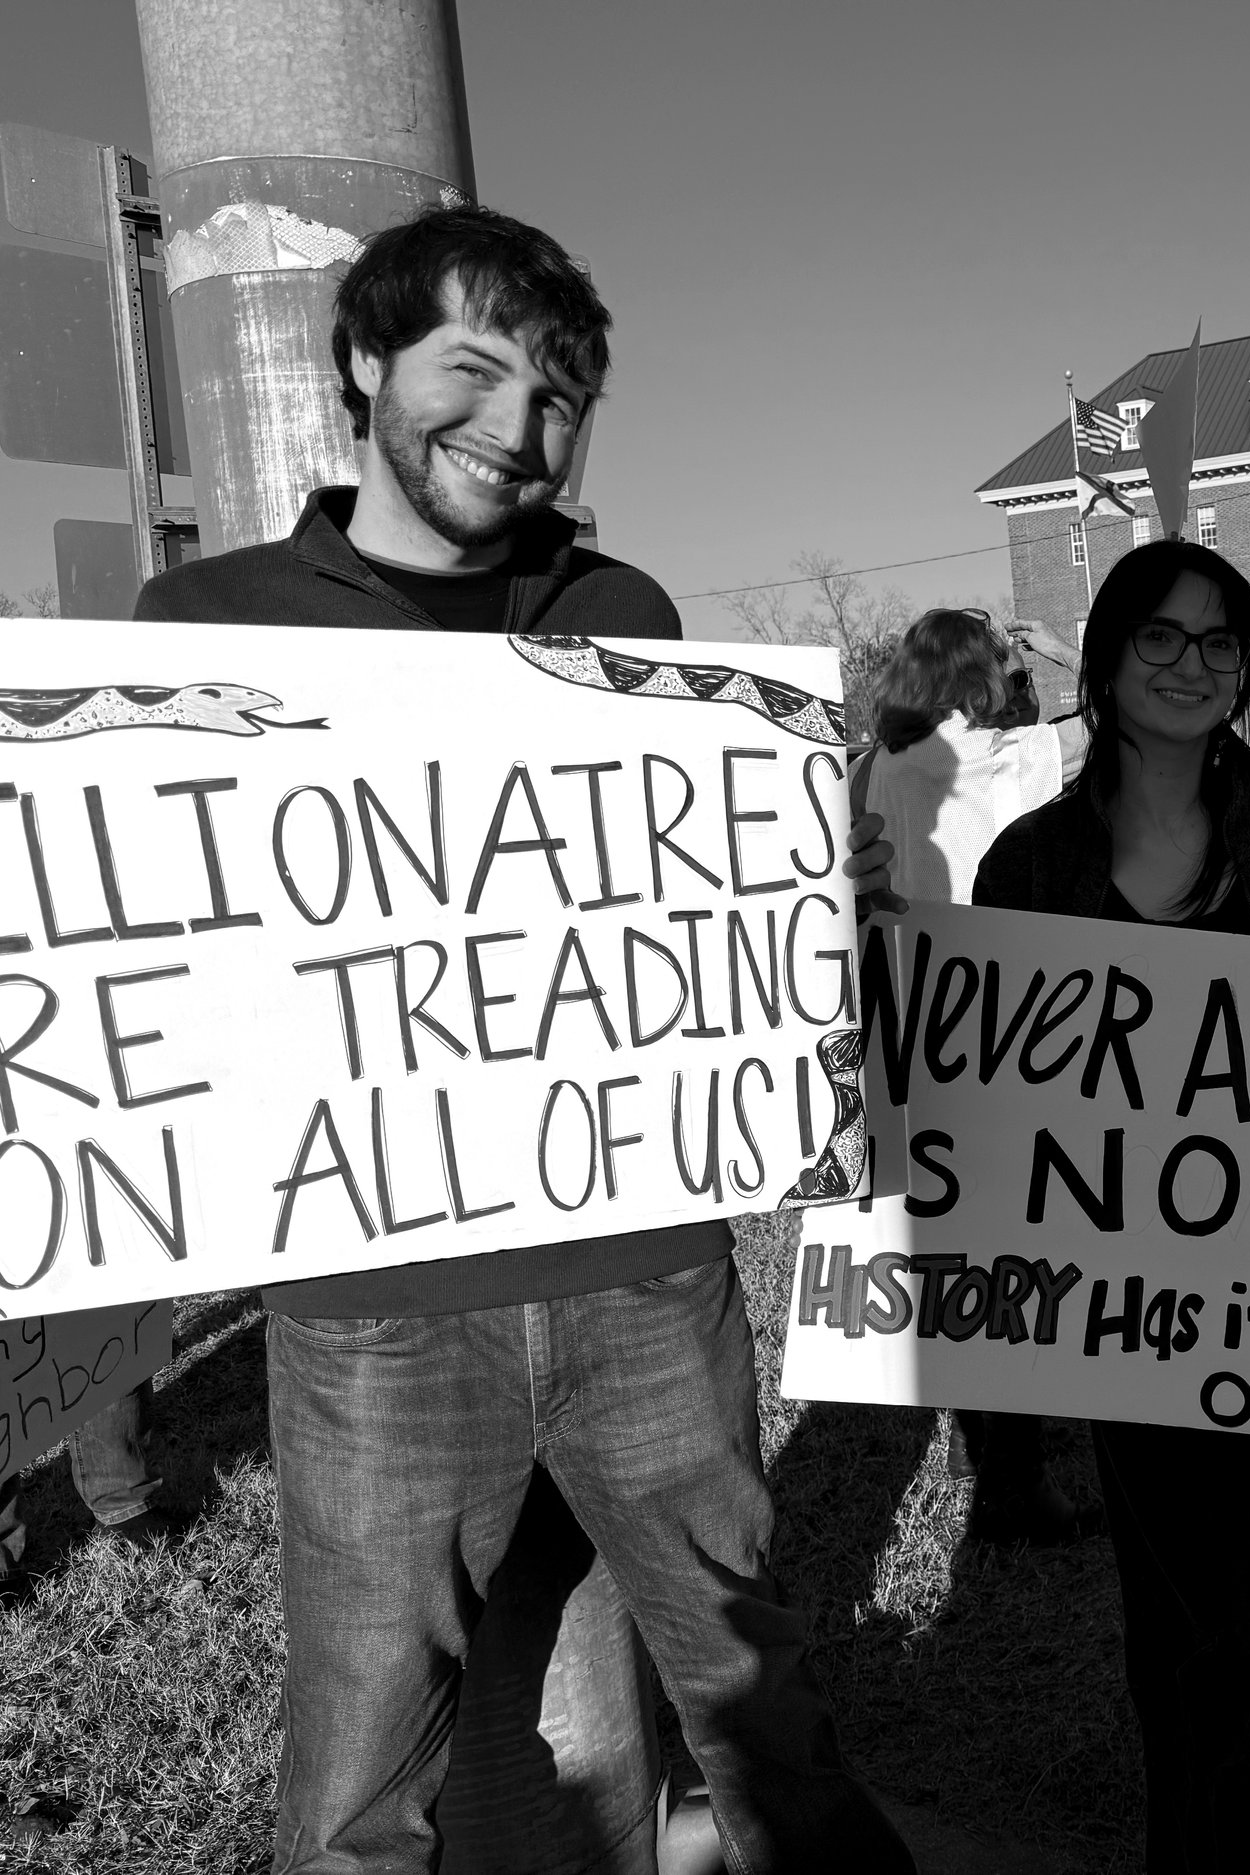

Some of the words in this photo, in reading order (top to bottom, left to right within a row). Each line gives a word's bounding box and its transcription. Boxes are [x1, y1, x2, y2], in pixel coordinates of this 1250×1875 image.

[0, 747, 844, 955] LLIONAIRES
[293, 895, 857, 1081] TREADING
[0, 1125, 187, 1290] ON
[272, 1087, 517, 1254] ALL
[538, 1076, 644, 1211] OF
[672, 1057, 816, 1203] US!
[800, 1243, 1083, 1345] HISTORY
